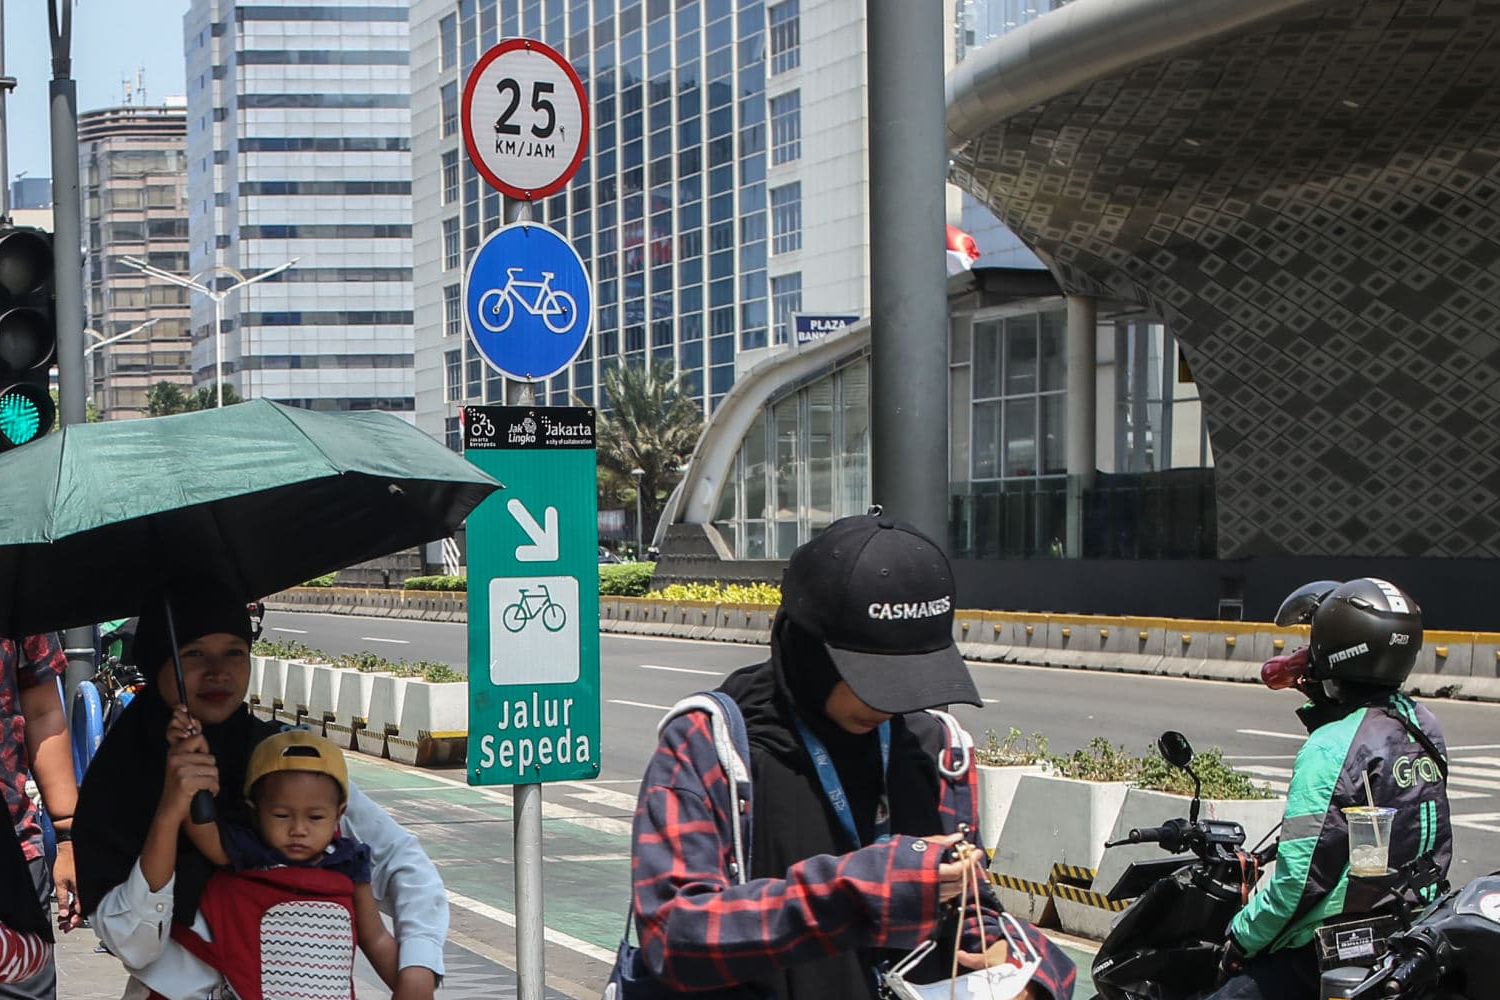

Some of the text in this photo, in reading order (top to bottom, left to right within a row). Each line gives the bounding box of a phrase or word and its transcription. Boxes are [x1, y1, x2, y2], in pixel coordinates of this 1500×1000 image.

[495, 78, 556, 139] 25
[495, 140, 555, 158] KM/JAM
[810, 319, 846, 330] PLAZA
[508, 423, 522, 434] Jak
[545, 421, 592, 436] Jakarta
[508, 433, 536, 446] Lingko
[498, 691, 574, 730] Jalur
[480, 727, 590, 776] Sepeda
[1392, 755, 1444, 788] Gra
